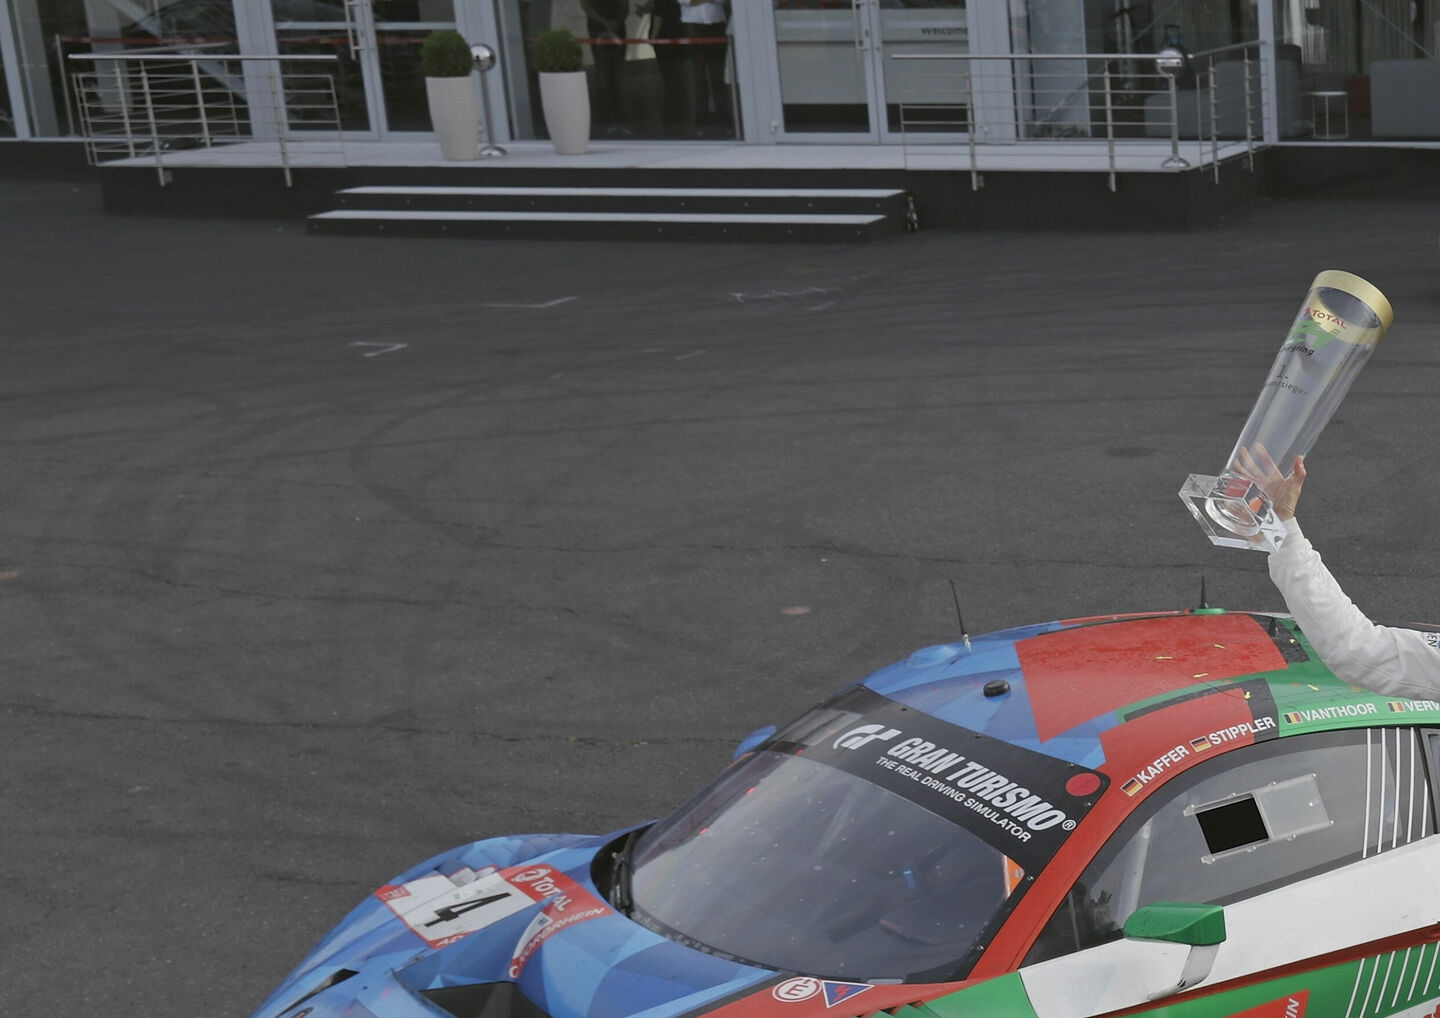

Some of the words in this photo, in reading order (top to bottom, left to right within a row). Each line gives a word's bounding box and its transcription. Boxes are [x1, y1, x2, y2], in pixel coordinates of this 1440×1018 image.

[1312, 309, 1347, 329] TOTAL
[1300, 703, 1378, 722] VANTHOOR
[887, 737, 965, 781] GRAN
[1136, 745, 1190, 784] KAFFER
[1208, 716, 1276, 745] STIPPLER
[876, 756, 897, 771] THE
[895, 764, 920, 782] REAL
[921, 775, 965, 803] DRIVING
[964, 797, 1032, 843] SIMULATOR
[424, 892, 512, 928] 4
[531, 875, 573, 911] TOTAL
